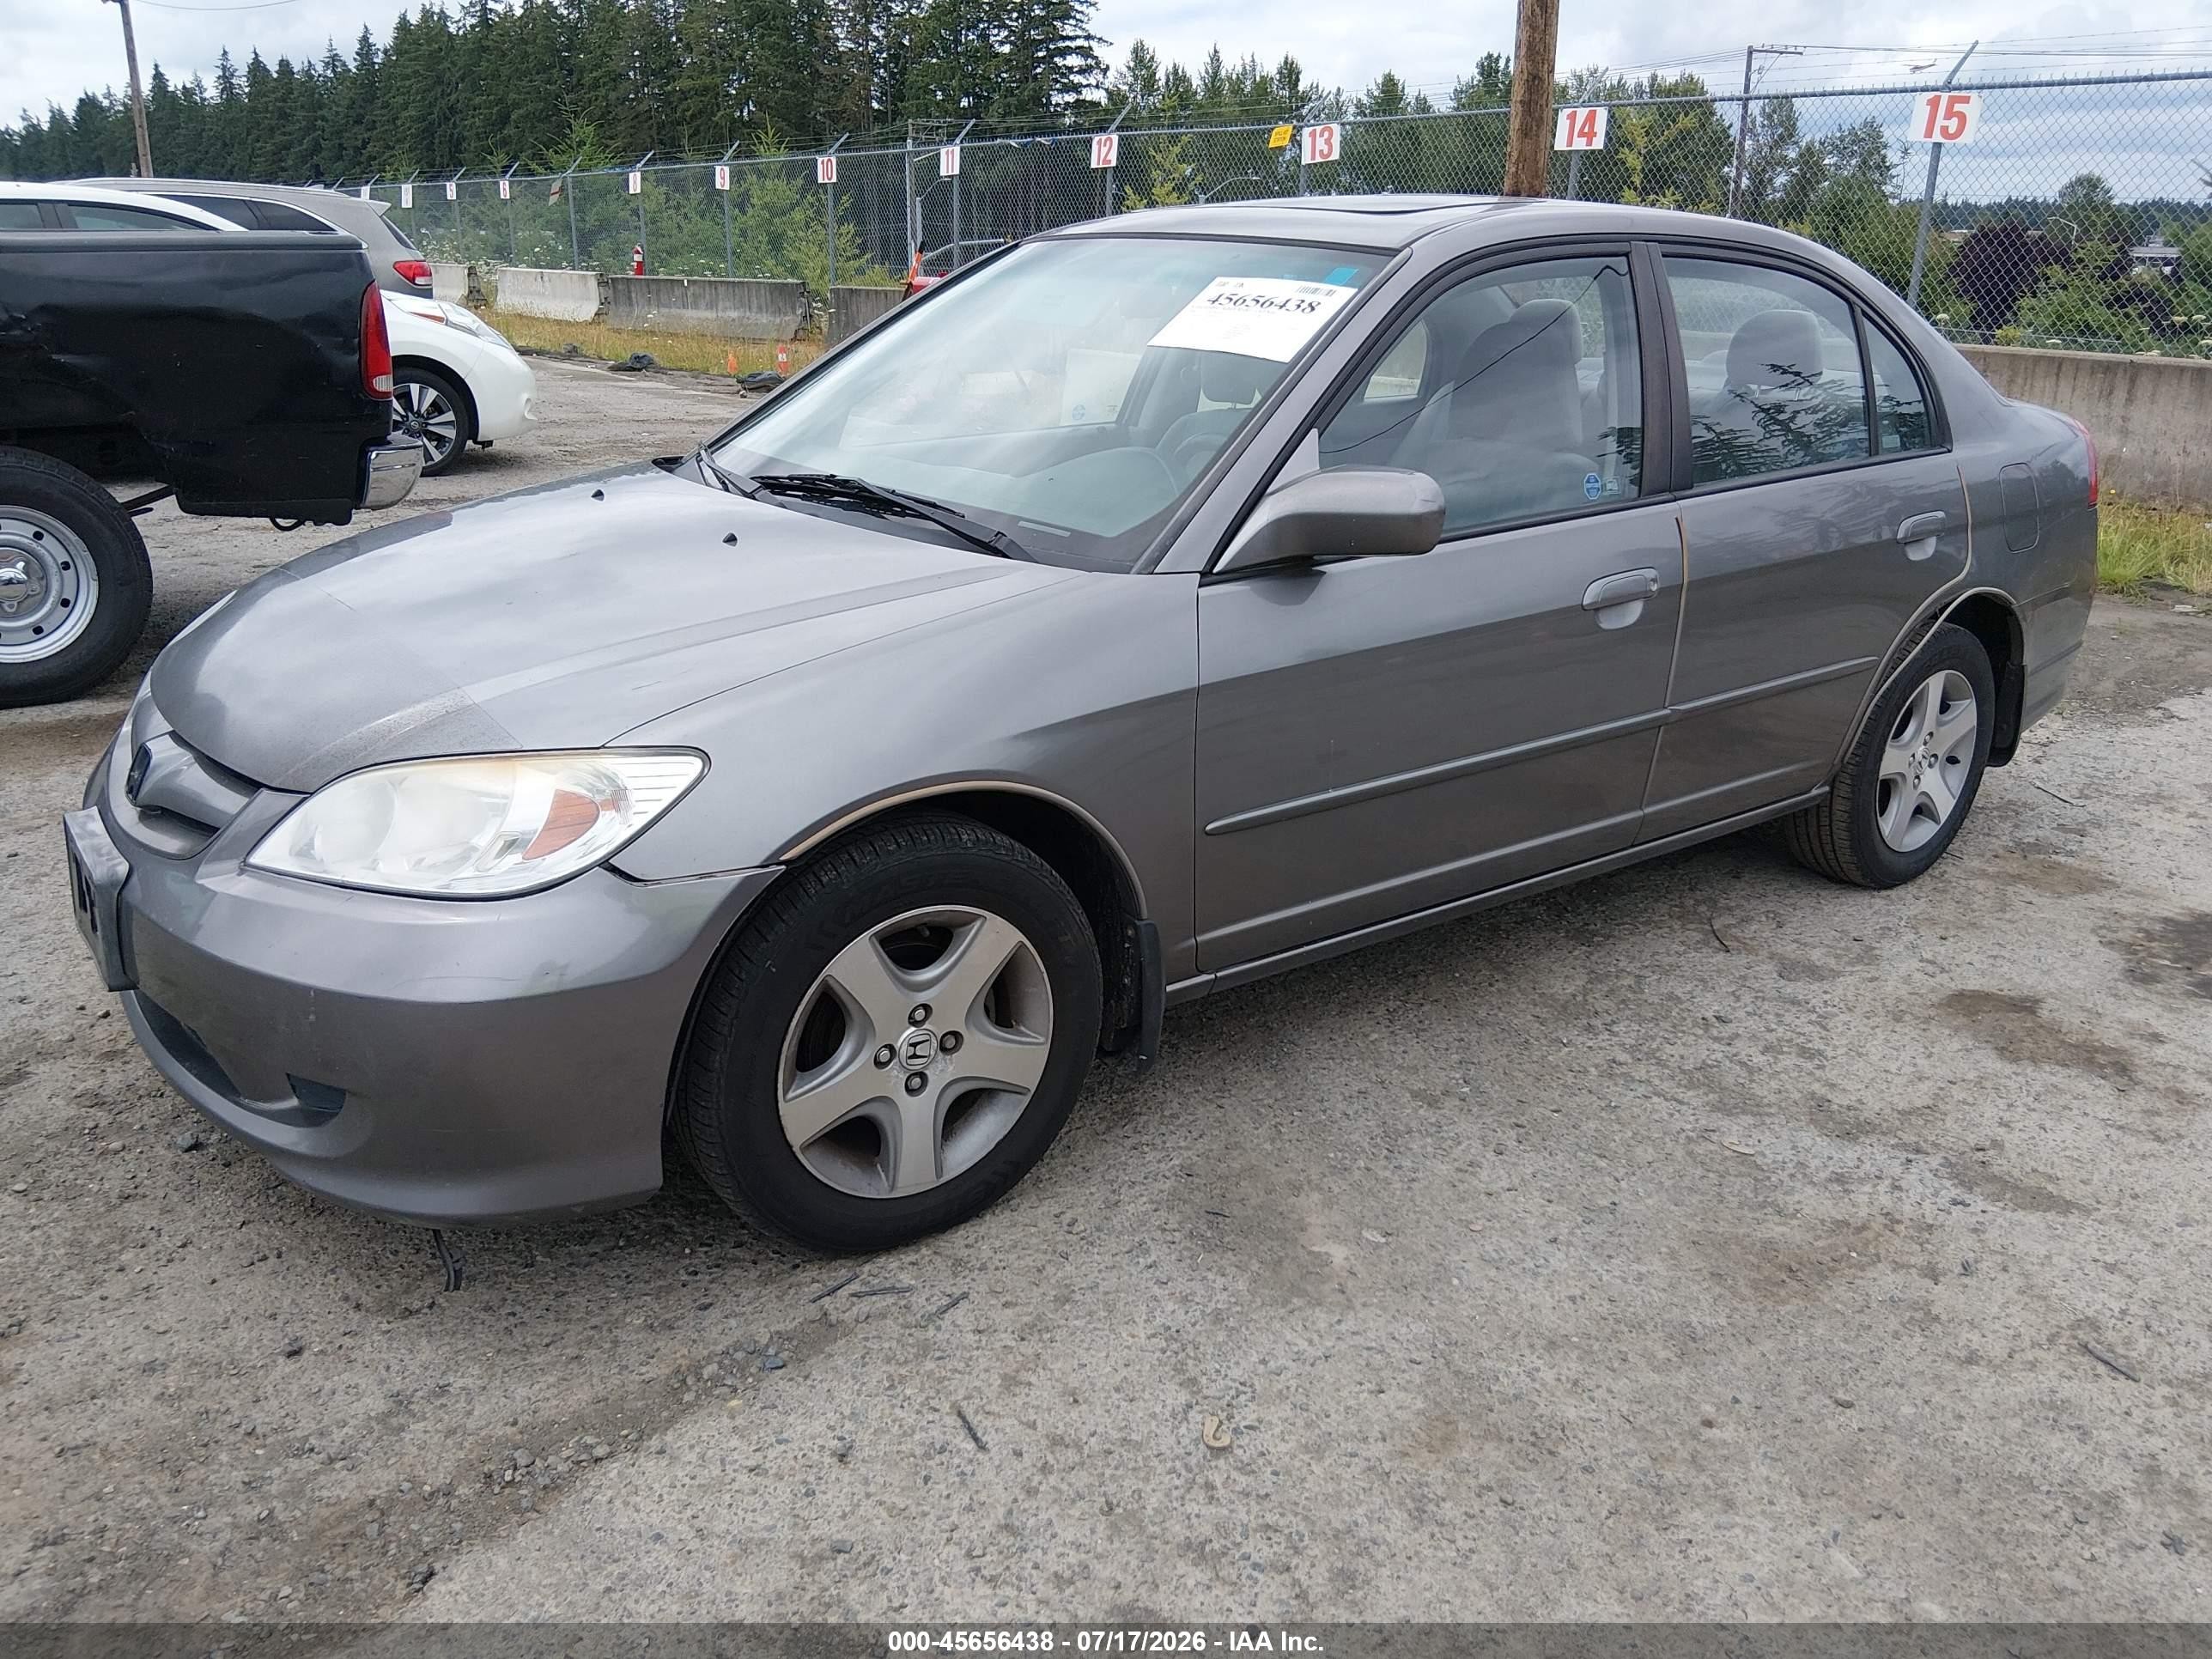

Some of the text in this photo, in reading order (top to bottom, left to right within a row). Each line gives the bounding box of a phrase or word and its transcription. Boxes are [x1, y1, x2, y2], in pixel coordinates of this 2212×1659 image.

[1565, 109, 1598, 148] 14
[1923, 94, 1972, 142] 15
[1096, 137, 1114, 167] 12
[1308, 127, 1334, 162] 13
[821, 158, 834, 182] 10
[945, 148, 955, 174] 11
[502, 181, 507, 198] 6
[632, 173, 638, 192] 8
[720, 167, 726, 188] 9
[449, 184, 454, 198] 5
[1207, 293, 1322, 313] 45656438
